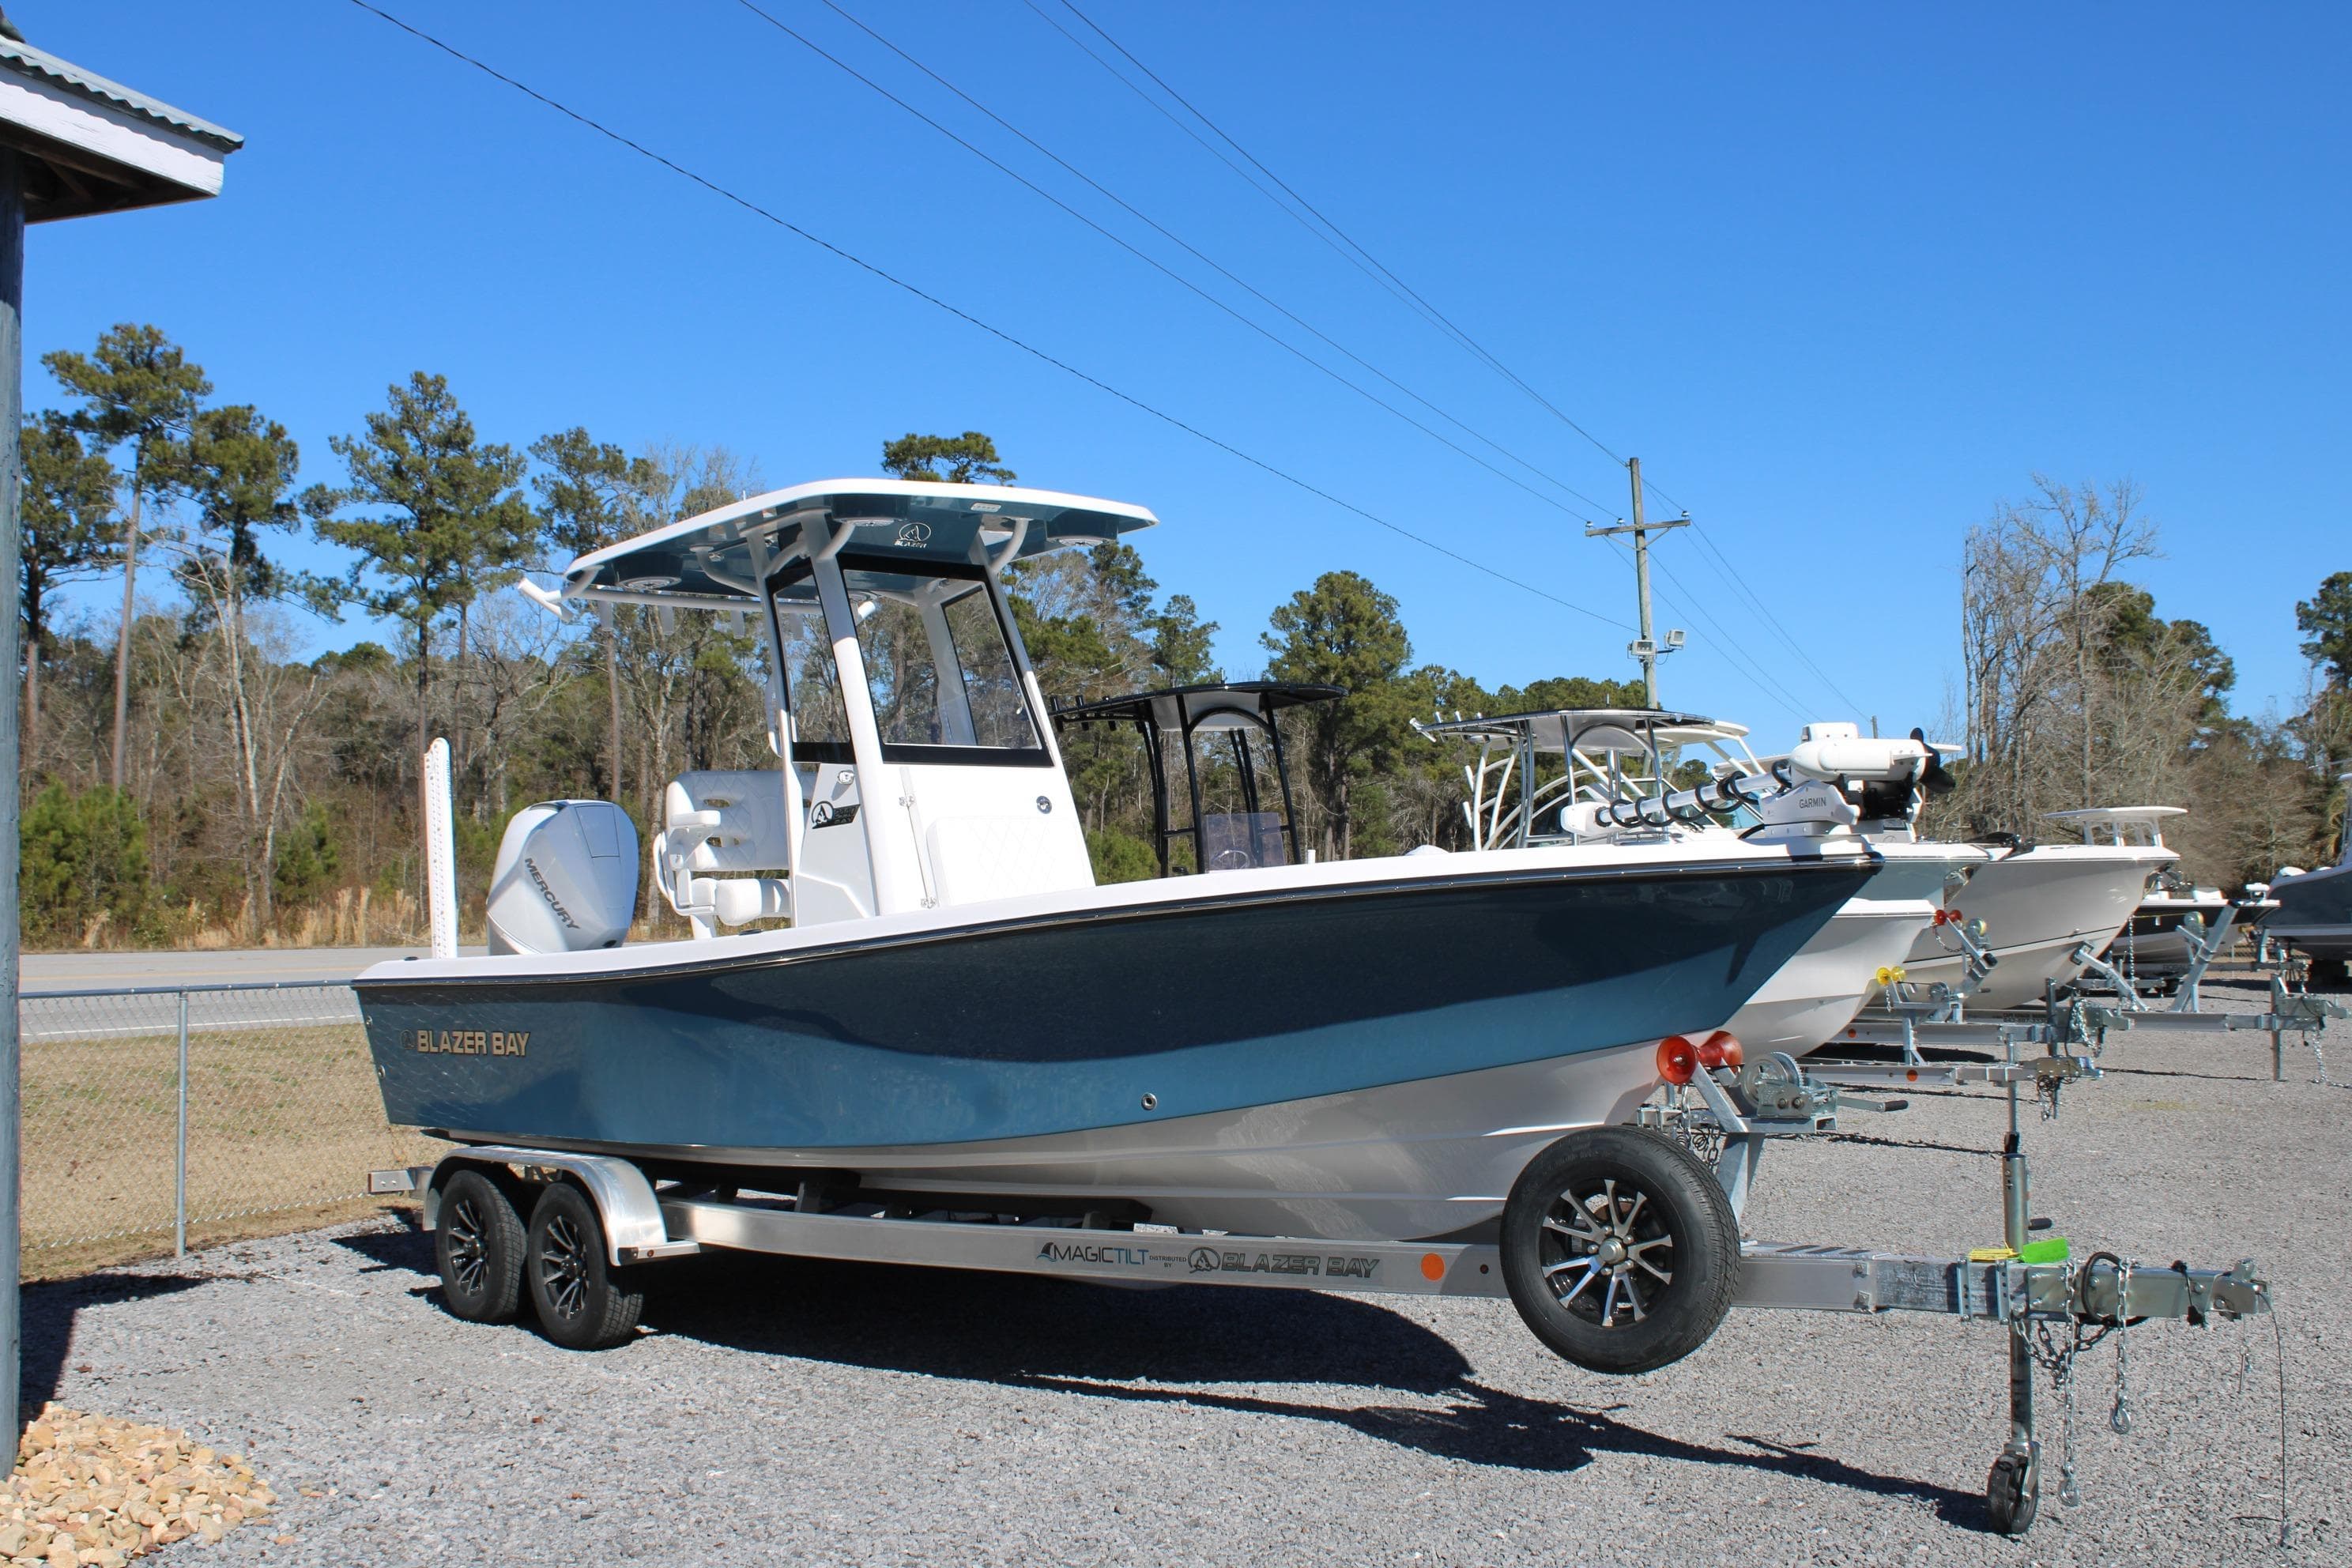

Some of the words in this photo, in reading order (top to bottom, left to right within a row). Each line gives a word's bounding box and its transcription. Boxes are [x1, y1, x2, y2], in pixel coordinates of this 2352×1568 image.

[1799, 796, 1827, 809] GARMIN
[524, 858, 582, 929] MERCURY
[416, 1030, 488, 1054] BLAZER
[492, 1031, 531, 1057] BAY
[1054, 1245, 1149, 1265] MAGICTILT
[1221, 1252, 1321, 1275] BLAZER
[1326, 1257, 1380, 1278] BAY
